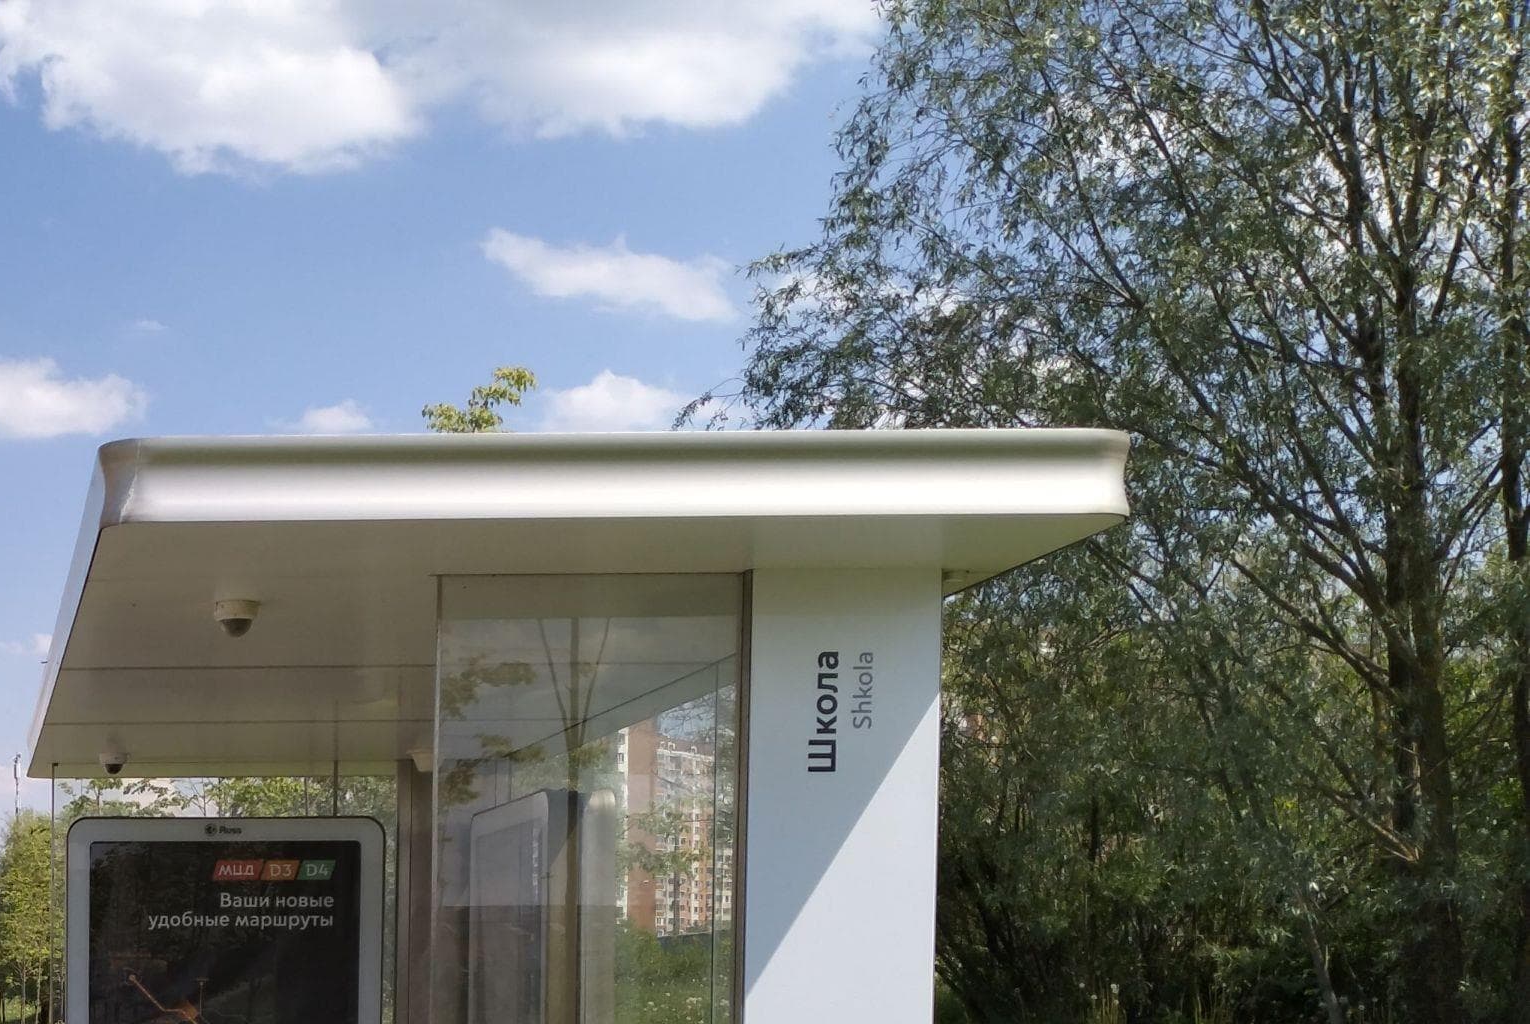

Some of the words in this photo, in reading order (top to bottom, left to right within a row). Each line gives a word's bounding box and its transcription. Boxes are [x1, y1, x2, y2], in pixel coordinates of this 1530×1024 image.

[851, 651, 874, 729] Shkola
[807, 651, 839, 773] Школа
[218, 863, 255, 876] МЦД
[270, 863, 292, 877] D3
[306, 863, 328, 877] D4
[220, 892, 270, 908] Ваши
[275, 894, 335, 908] новые
[148, 911, 230, 930] удобные
[235, 914, 334, 930] маршруты
